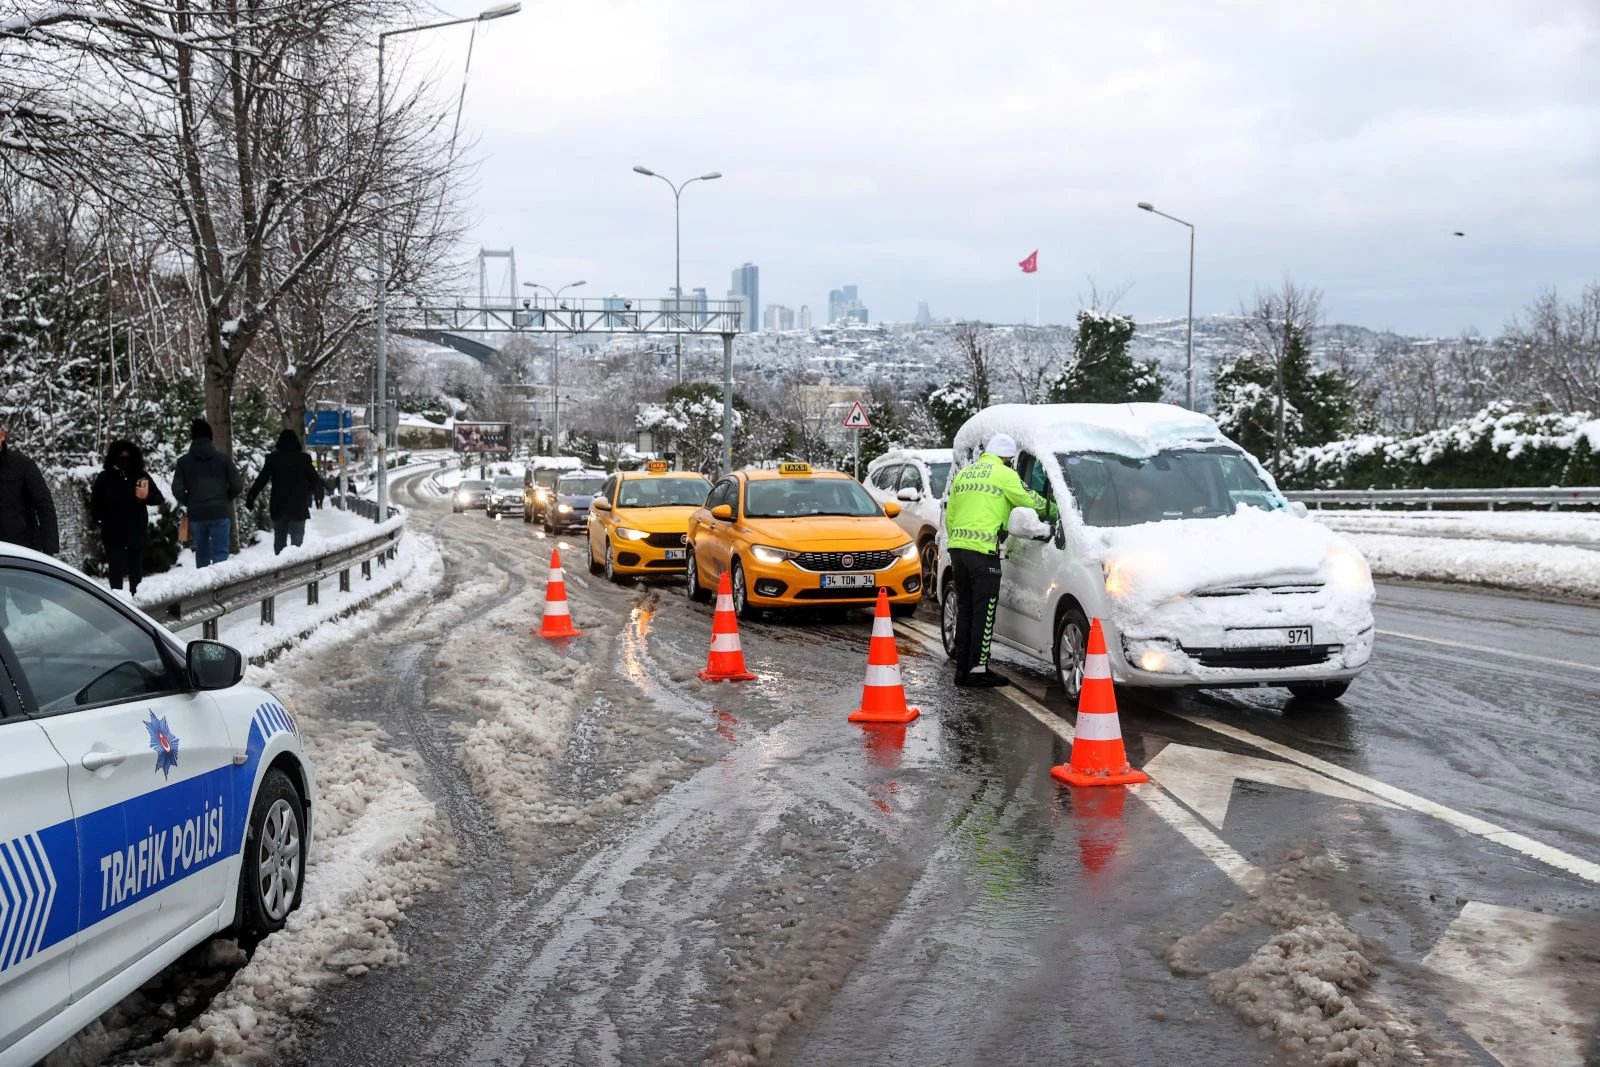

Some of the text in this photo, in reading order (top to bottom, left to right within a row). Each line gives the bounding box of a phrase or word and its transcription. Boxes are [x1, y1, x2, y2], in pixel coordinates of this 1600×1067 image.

[826, 576, 836, 586] 34
[863, 575, 873, 585] 34
[1288, 629, 1309, 644] 971
[100, 795, 223, 912] TRAFİK POLİSİ
